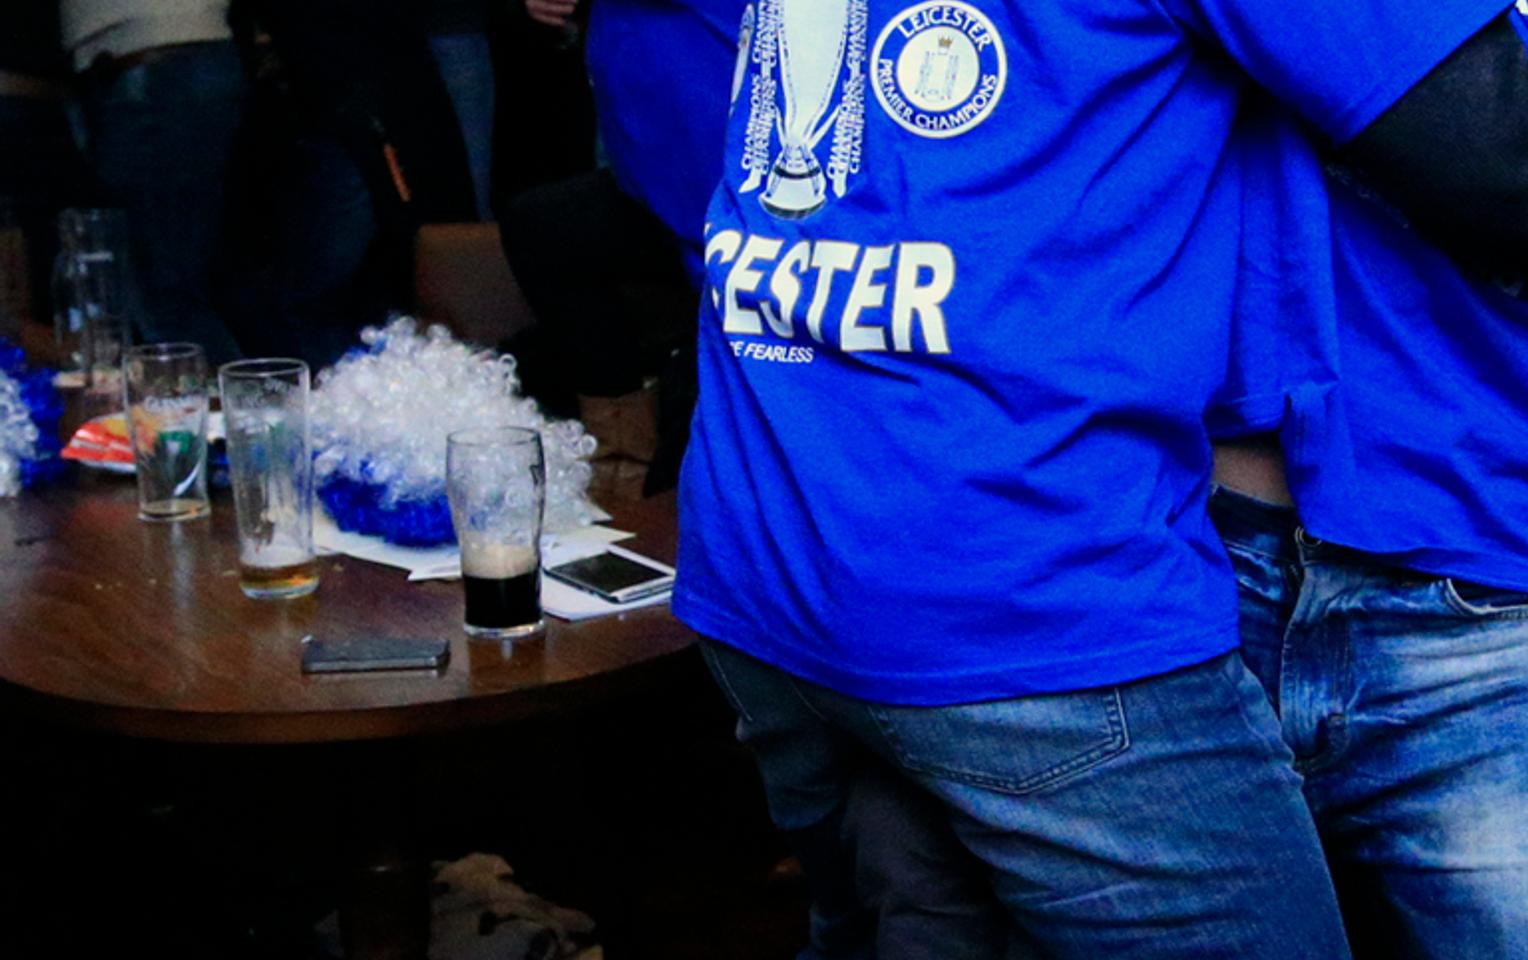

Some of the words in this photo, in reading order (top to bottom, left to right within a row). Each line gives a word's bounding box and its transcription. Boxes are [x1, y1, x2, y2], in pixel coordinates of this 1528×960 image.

[898, 5, 993, 51] LEICESTER
[879, 58, 914, 121] PREMIER
[915, 74, 997, 130] CHAMPIONS
[704, 227, 955, 353] CESTER
[743, 343, 814, 363] FEARLESS
